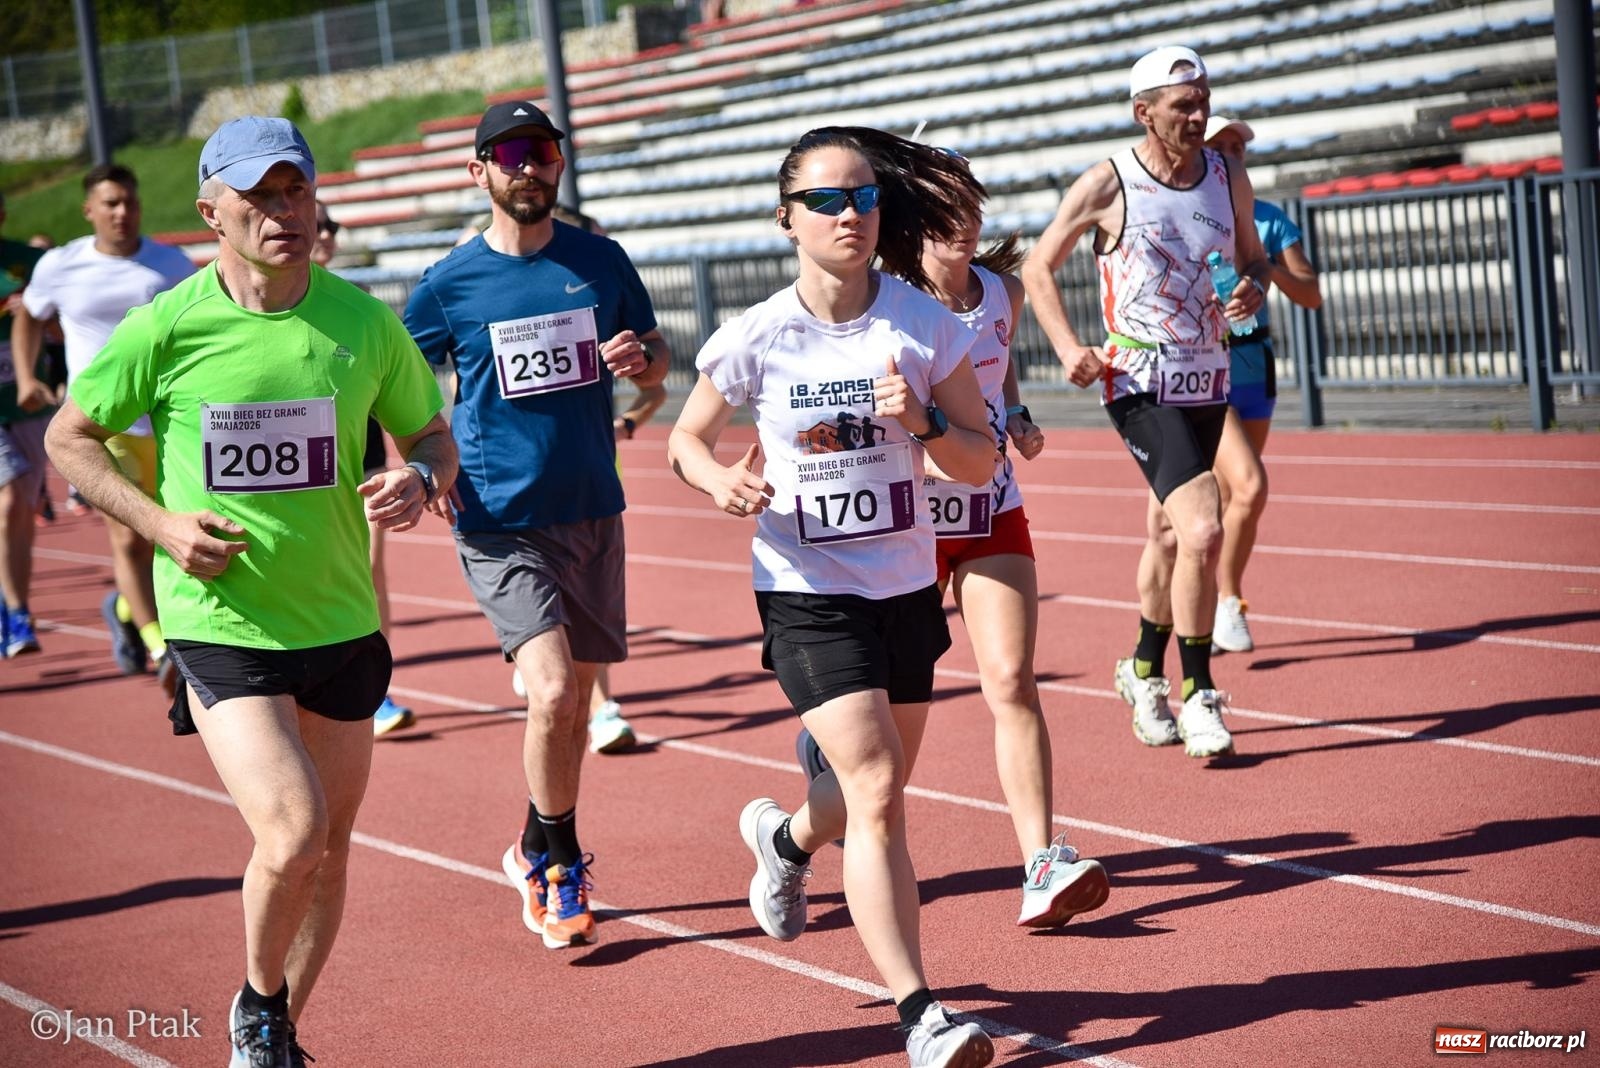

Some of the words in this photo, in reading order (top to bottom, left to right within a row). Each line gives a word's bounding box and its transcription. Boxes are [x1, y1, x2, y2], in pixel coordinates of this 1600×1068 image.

[498, 327, 514, 336] XVIII
[516, 324, 532, 333] BIEG
[533, 321, 546, 330] BEZ
[547, 317, 573, 328] GRANIC
[499, 331, 539, 345] 3MAJA2026
[510, 346, 572, 382] 235
[1170, 370, 1211, 394] 203
[790, 397, 824, 408] BIEG
[210, 410, 231, 420] XVIII
[233, 410, 254, 420] BIEG
[256, 409, 272, 419] BEZ
[274, 407, 307, 417] GRANIC
[210, 421, 261, 431] 3MAJA2026
[219, 441, 300, 477] 208
[798, 462, 816, 473] XVIII
[819, 460, 837, 471] BIEG
[840, 458, 855, 468] BEZ
[856, 453, 886, 466] GRANIC
[798, 470, 845, 483] 3MAJA2026
[815, 489, 878, 528] 170
